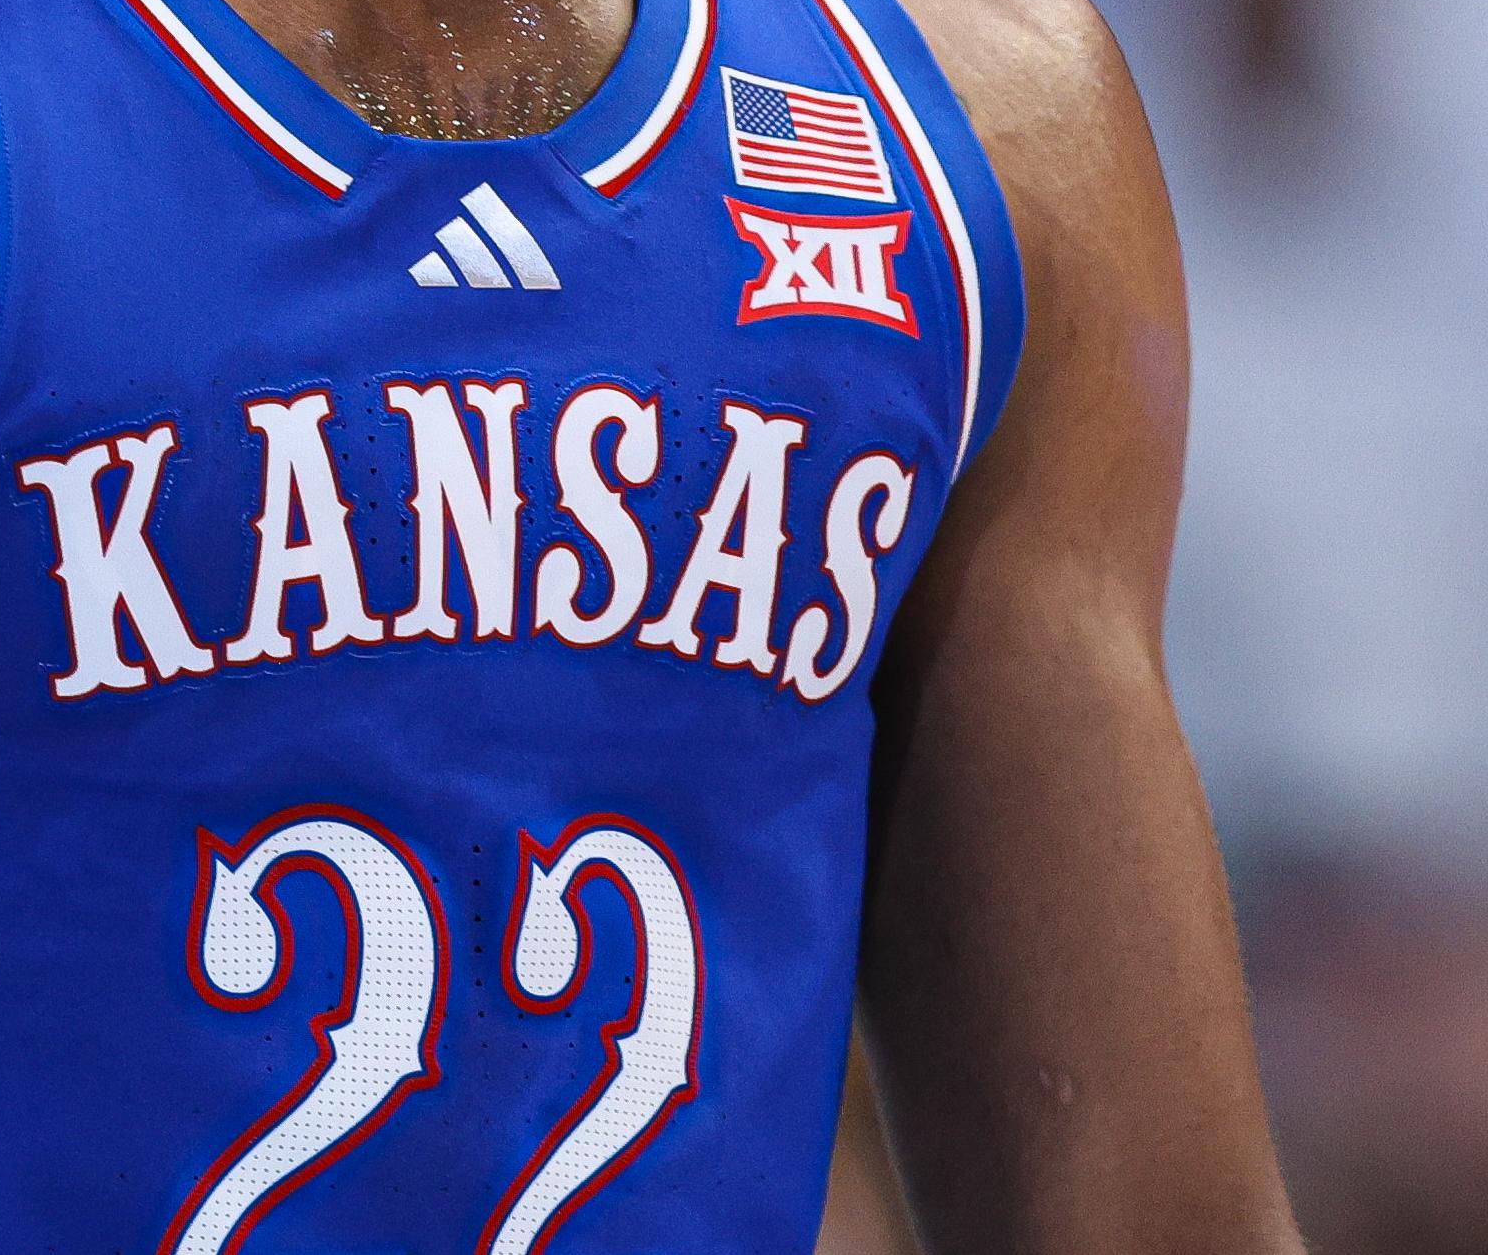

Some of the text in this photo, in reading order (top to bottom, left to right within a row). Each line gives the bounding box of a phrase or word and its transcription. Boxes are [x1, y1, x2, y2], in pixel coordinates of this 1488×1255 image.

[735, 208, 911, 325] XII
[17, 380, 914, 702] KANSAS
[157, 803, 705, 1255] 22
